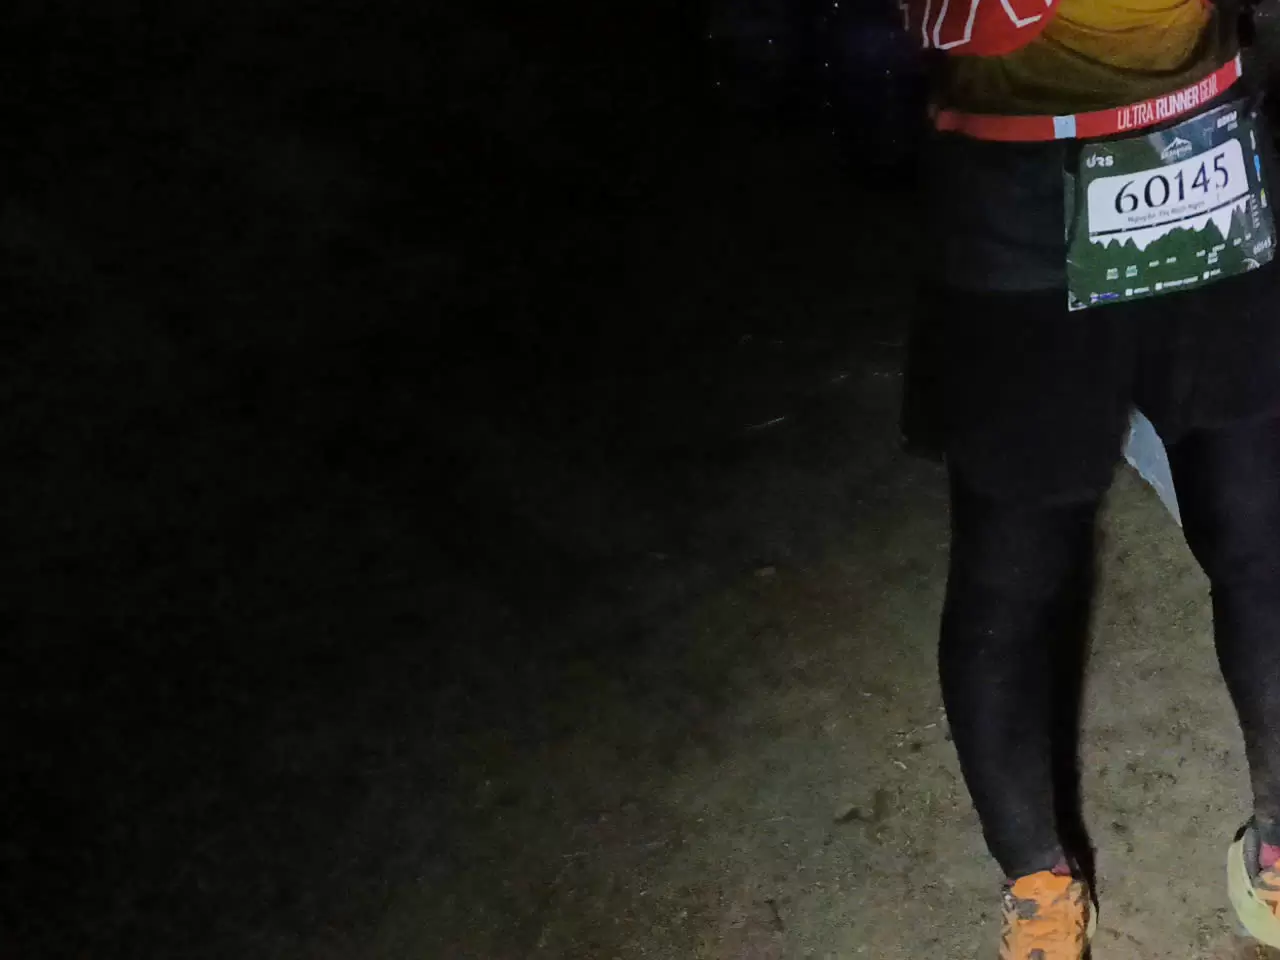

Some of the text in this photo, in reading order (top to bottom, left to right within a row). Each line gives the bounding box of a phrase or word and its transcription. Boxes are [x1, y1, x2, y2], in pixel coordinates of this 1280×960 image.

[1117, 104, 1154, 130] ULTRA
[1155, 84, 1199, 120] RUNNER
[1114, 152, 1229, 215] 60145
